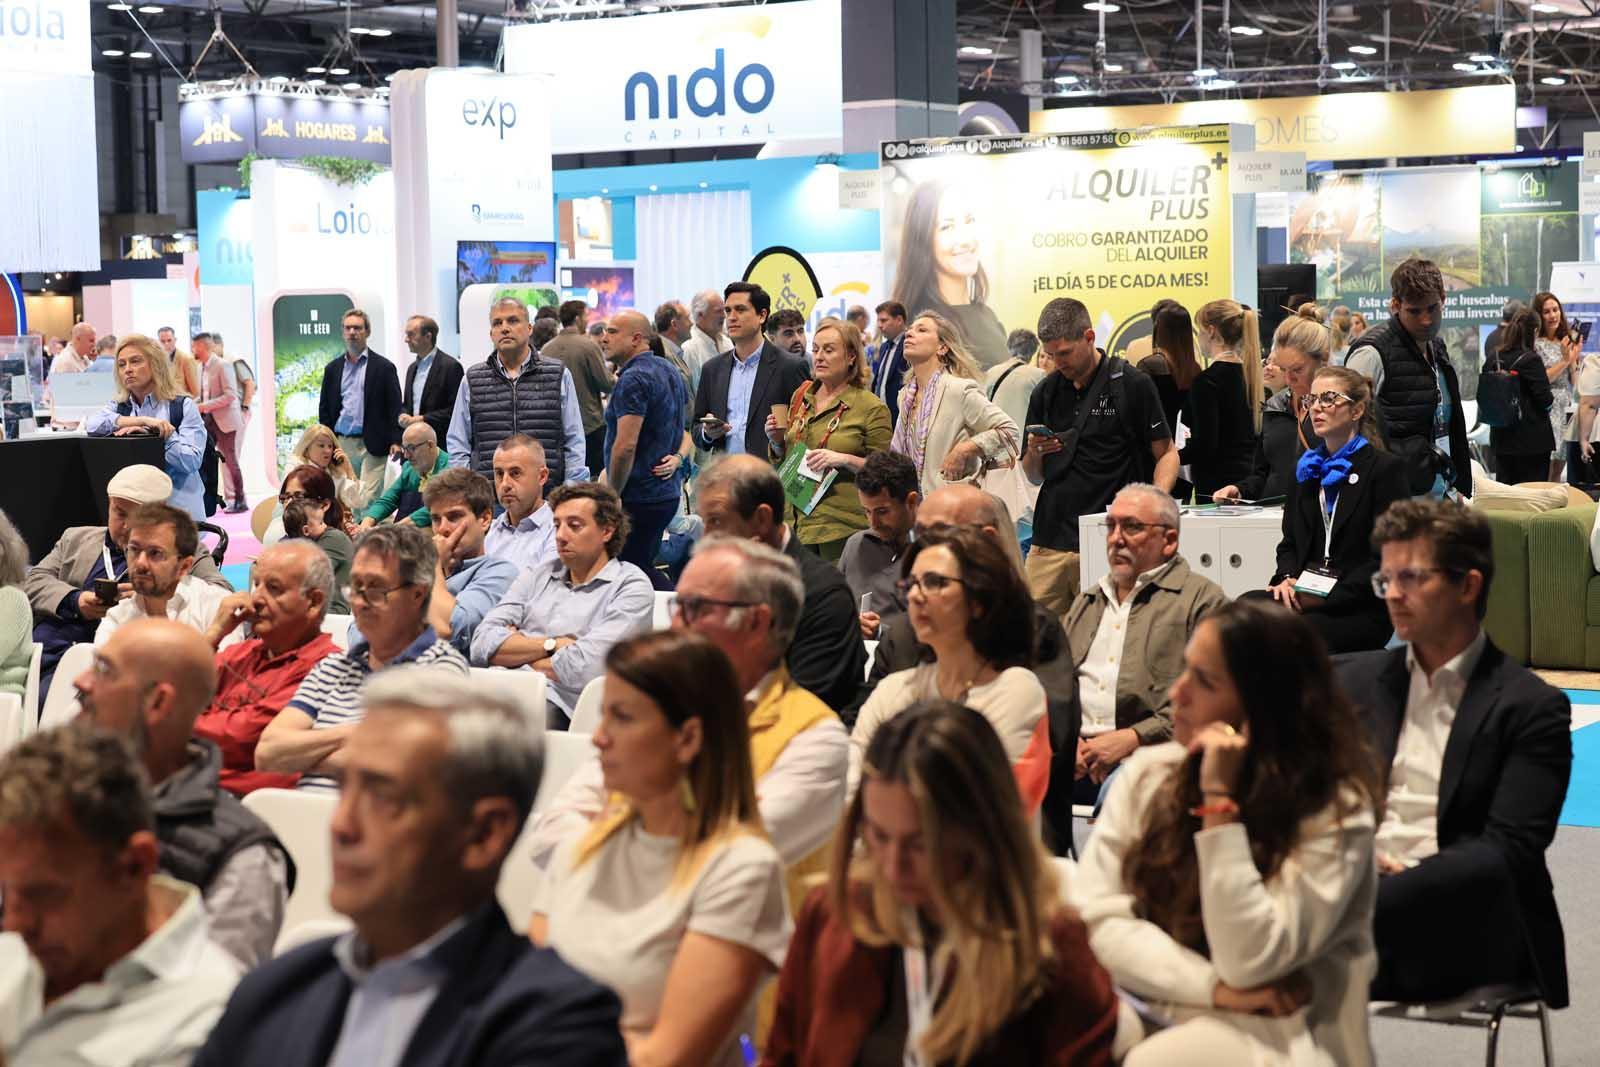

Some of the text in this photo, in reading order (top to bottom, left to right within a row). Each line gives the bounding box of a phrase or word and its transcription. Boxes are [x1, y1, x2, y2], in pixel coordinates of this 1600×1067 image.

[624, 47, 775, 121] nido
[462, 95, 517, 141] exp
[295, 121, 358, 141] HOGARES
[623, 123, 775, 143] CAPITAL
[1061, 136, 1070, 146] 91
[1089, 135, 1101, 145] 57
[1047, 165, 1212, 203] ALQUILER
[1149, 198, 1209, 221] PLUS
[1032, 228, 1208, 249] COBRO GARANTIZADO
[1106, 245, 1208, 263] DEL ALQUILER
[1033, 271, 1209, 293] ¡EL DÍA 5 DE CADA MES!
[1358, 296, 1380, 308] Esta
